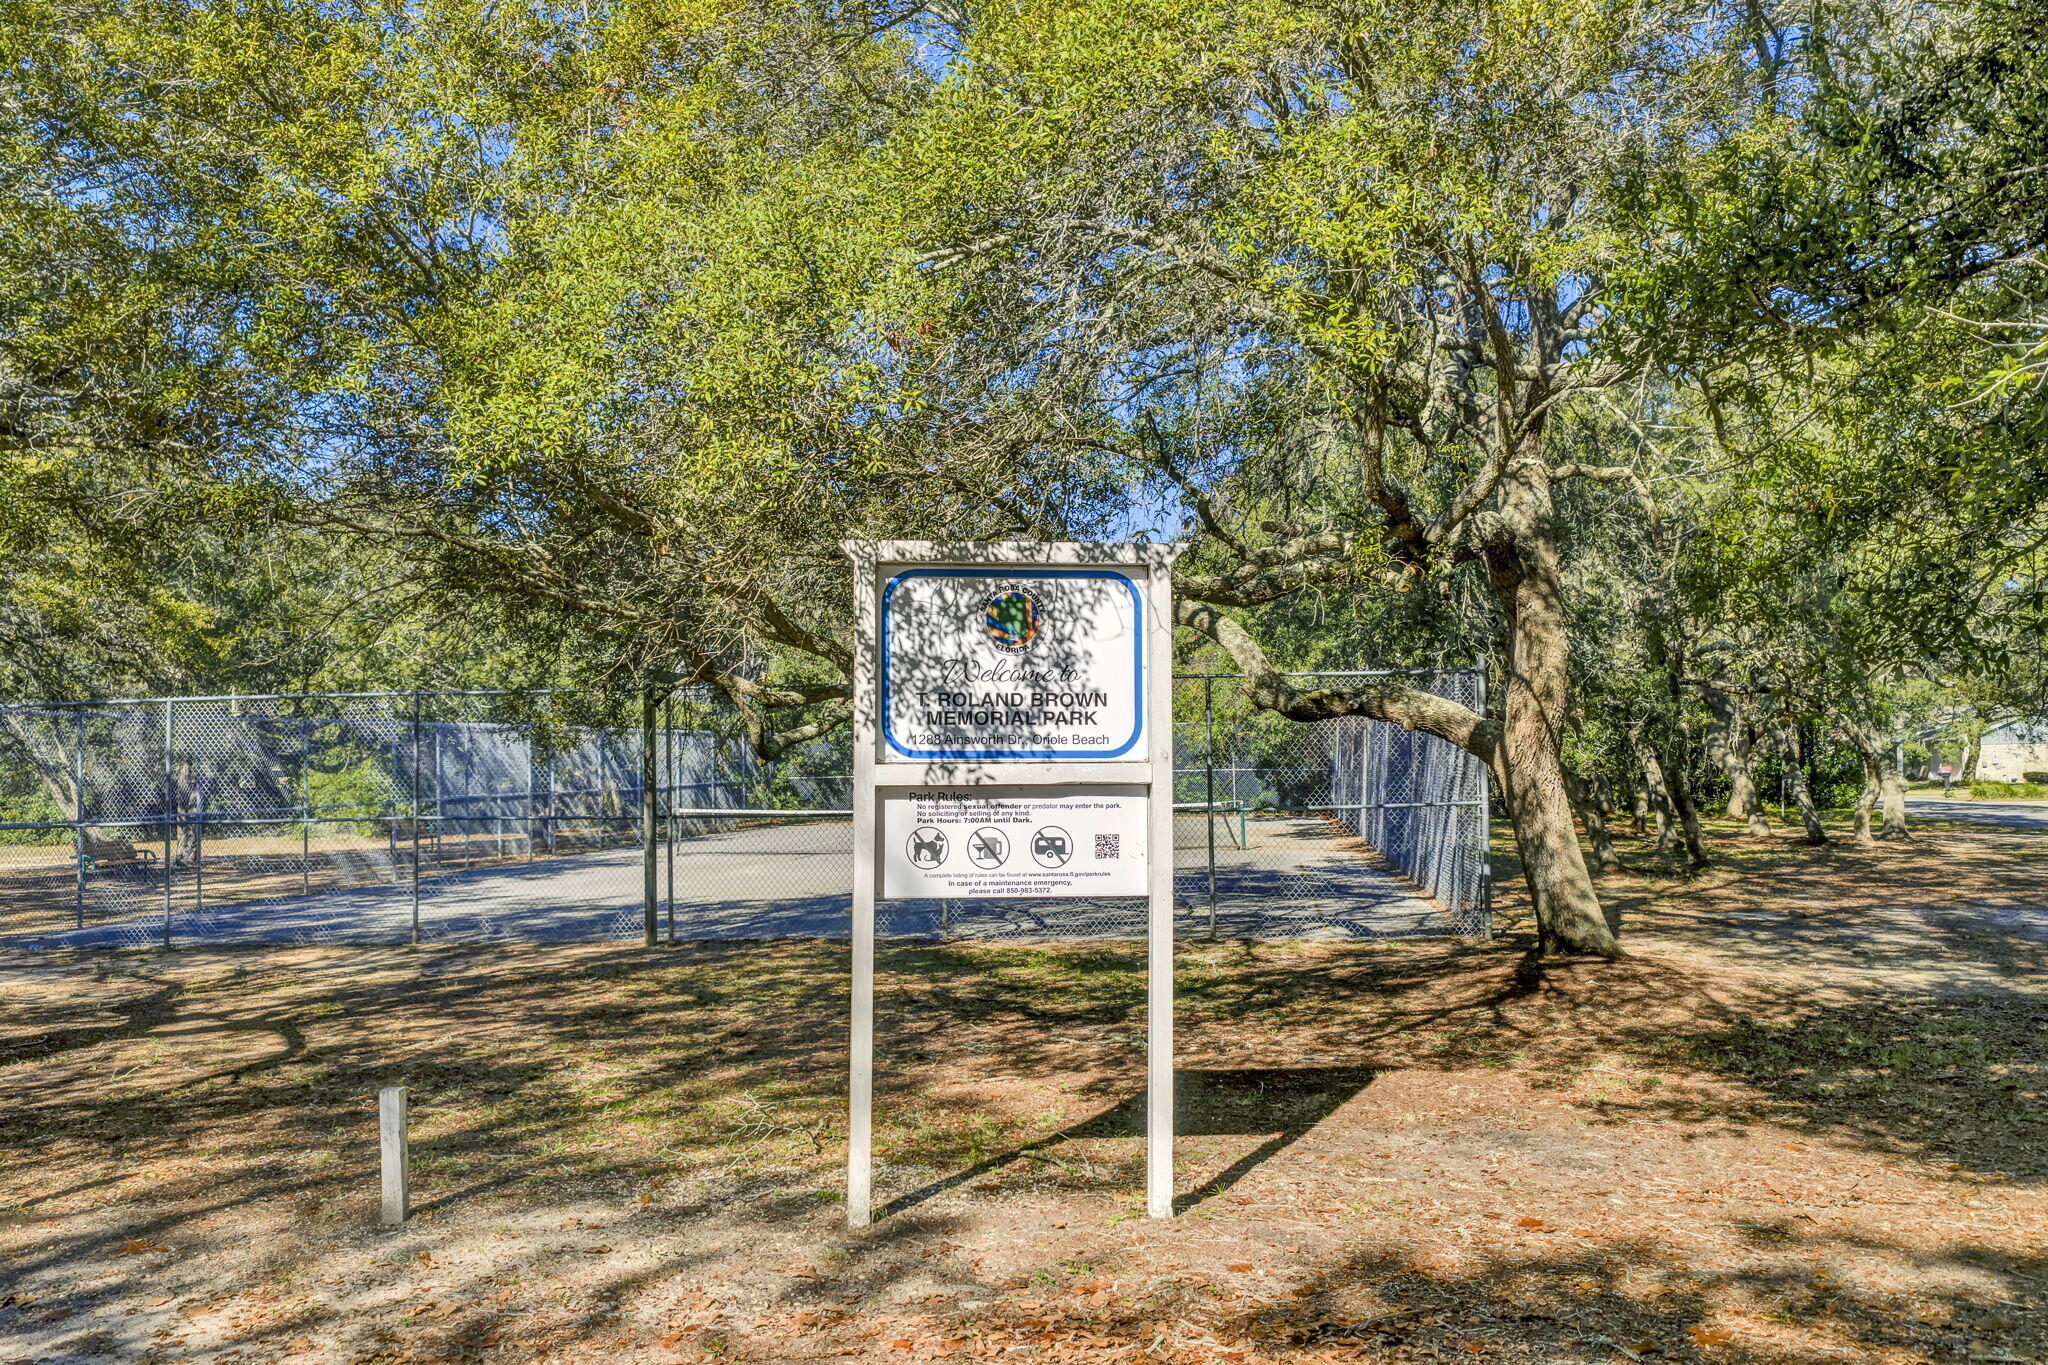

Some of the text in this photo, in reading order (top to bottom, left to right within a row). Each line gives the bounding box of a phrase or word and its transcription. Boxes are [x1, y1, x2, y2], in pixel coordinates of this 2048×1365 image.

[980, 591, 998, 613] SANTA
[1022, 588, 1046, 613] COUNTY
[996, 644, 1030, 653] FLORIDA
[944, 658, 1081, 684] Welcome to
[916, 692, 1107, 707] T. ROLAND BROWN
[927, 711, 1098, 726] MEMORIAL PARK
[912, 734, 940, 744] 1288
[944, 734, 1003, 744] Ainsworth
[1032, 734, 1068, 744] Oriole
[1072, 734, 1109, 744] Beach
[909, 792, 972, 802] Park Rules:
